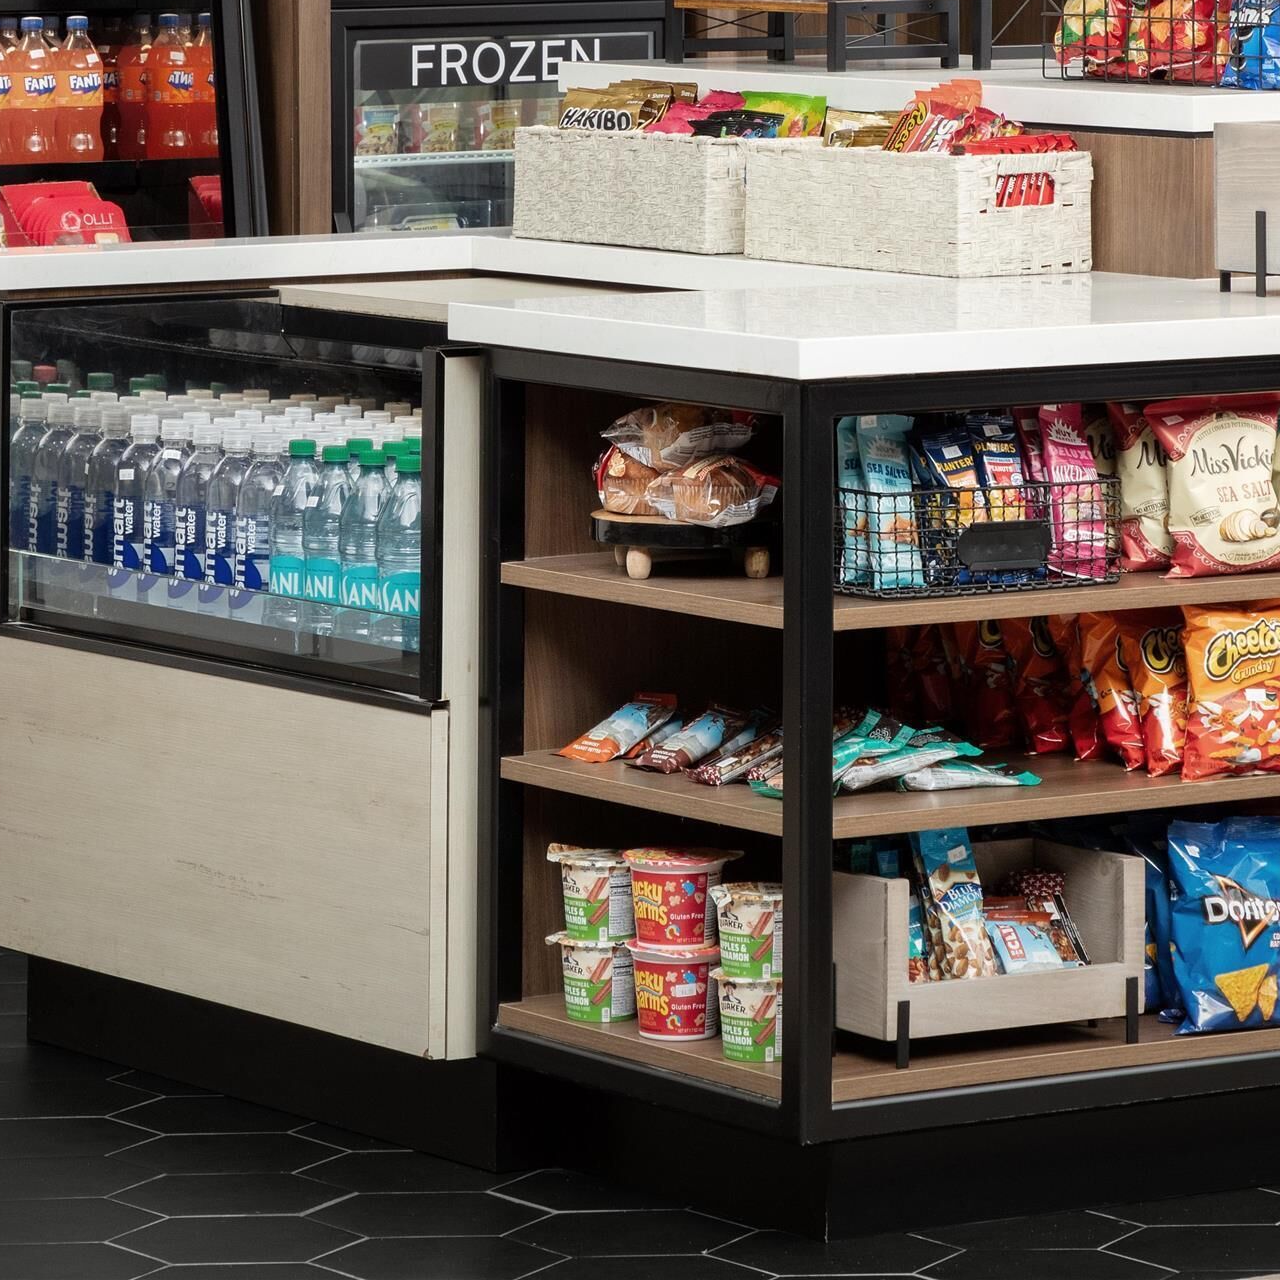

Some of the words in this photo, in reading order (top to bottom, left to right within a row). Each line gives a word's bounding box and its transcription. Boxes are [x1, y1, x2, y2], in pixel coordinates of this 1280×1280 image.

[560, 108, 631, 131] HARIBO
[83, 213, 113, 226] OLLI
[1055, 430, 1071, 438] NUT
[975, 442, 1016, 453] PLANTERS
[867, 462, 883, 474] SEA
[1190, 448, 1230, 477] Miss
[1216, 487, 1238, 503] SEA
[1242, 480, 1272, 500] SALT
[124, 499, 134, 535] water
[152, 503, 162, 538] water
[186, 508, 196, 544] water
[108, 498, 124, 576] smart
[217, 513, 226, 549] water
[246, 518, 256, 554] water
[169, 507, 186, 586] smart
[200, 511, 217, 591] smart
[230, 517, 247, 597] smart
[1232, 658, 1276, 684] Crunchy
[947, 883, 976, 901] BLUE
[579, 907, 584, 917] &
[740, 943, 747, 951] &
[581, 988, 587, 997] &
[671, 1003, 692, 1011] Gluten
[743, 1027, 749, 1036] &
